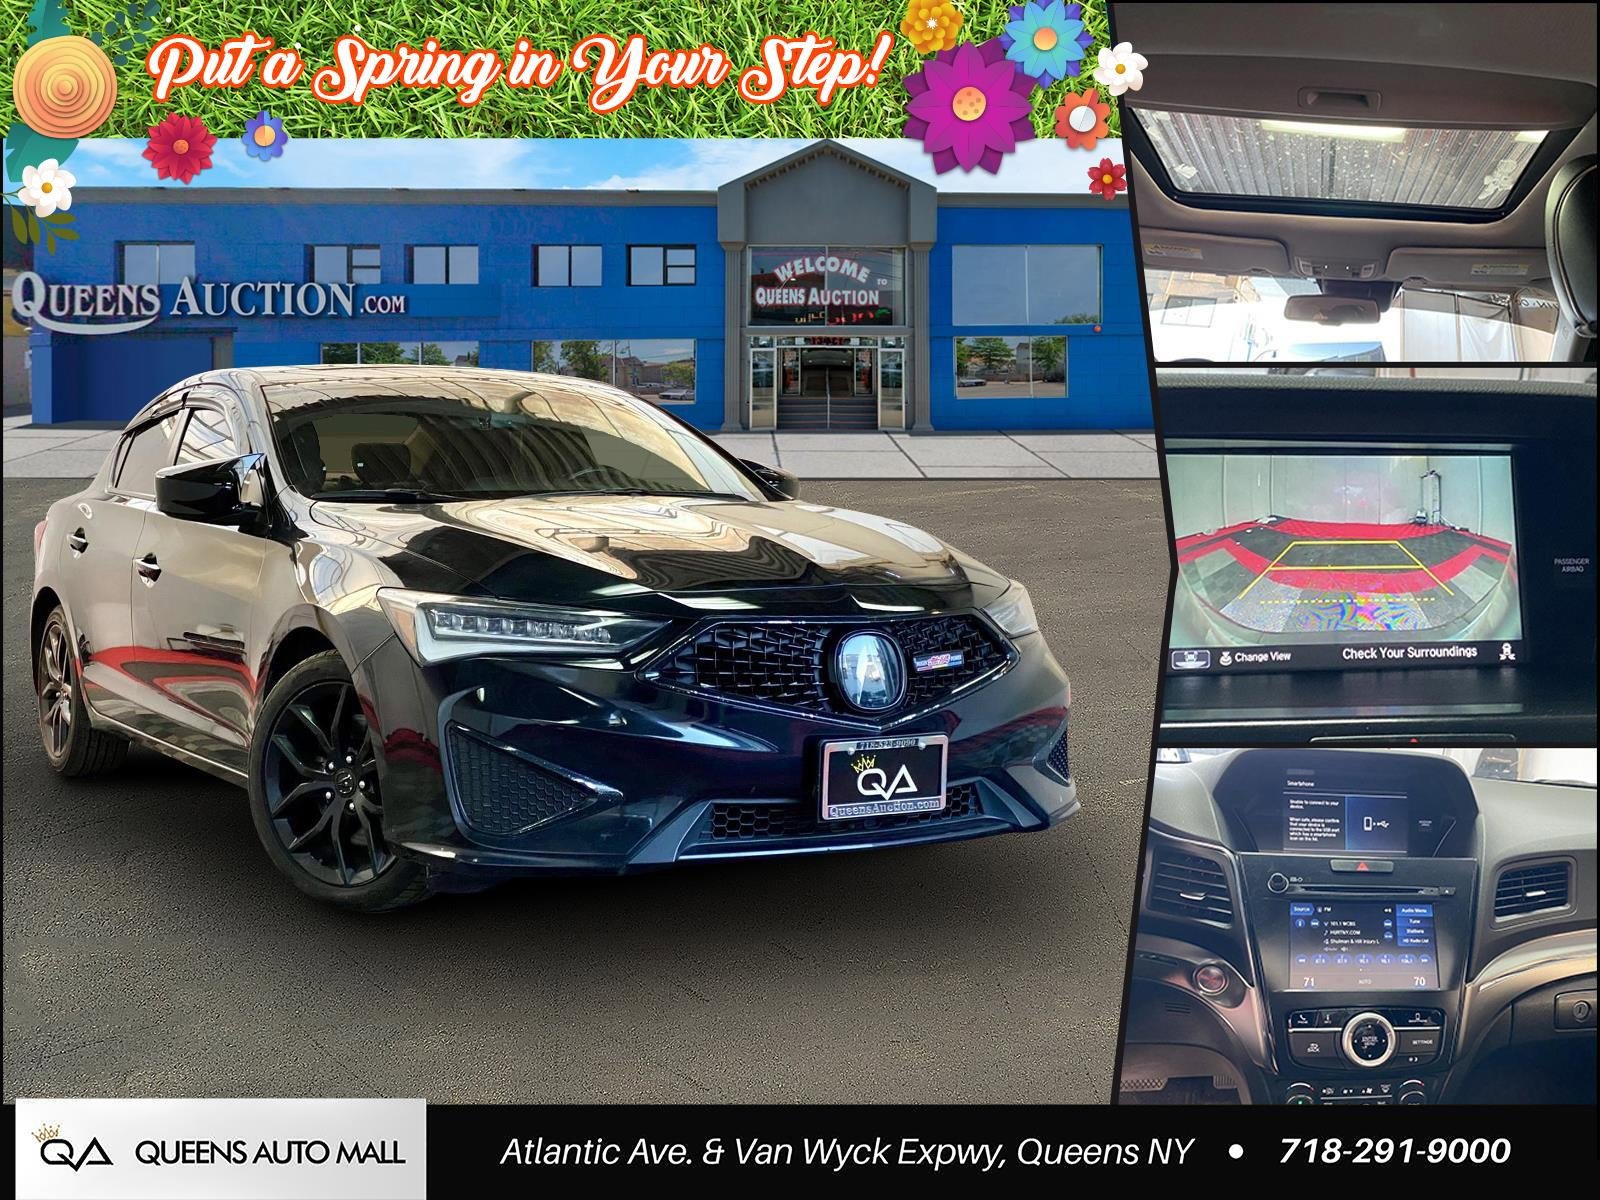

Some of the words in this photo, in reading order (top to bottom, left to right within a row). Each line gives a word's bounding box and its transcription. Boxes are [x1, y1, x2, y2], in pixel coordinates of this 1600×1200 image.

[773, 256, 871, 283] WELCOME
[755, 287, 806, 307] QUEENS
[808, 287, 879, 306] AUCTION
[1234, 652, 1268, 663] Change
[1269, 651, 1292, 661] View
[1342, 648, 1377, 660] Check
[1379, 647, 1404, 659] Your
[1407, 646, 1478, 659] Surroundings
[829, 800, 941, 818] QueensAuction.com
[1304, 977, 1315, 986] 71
[1414, 976, 1426, 986] 70
